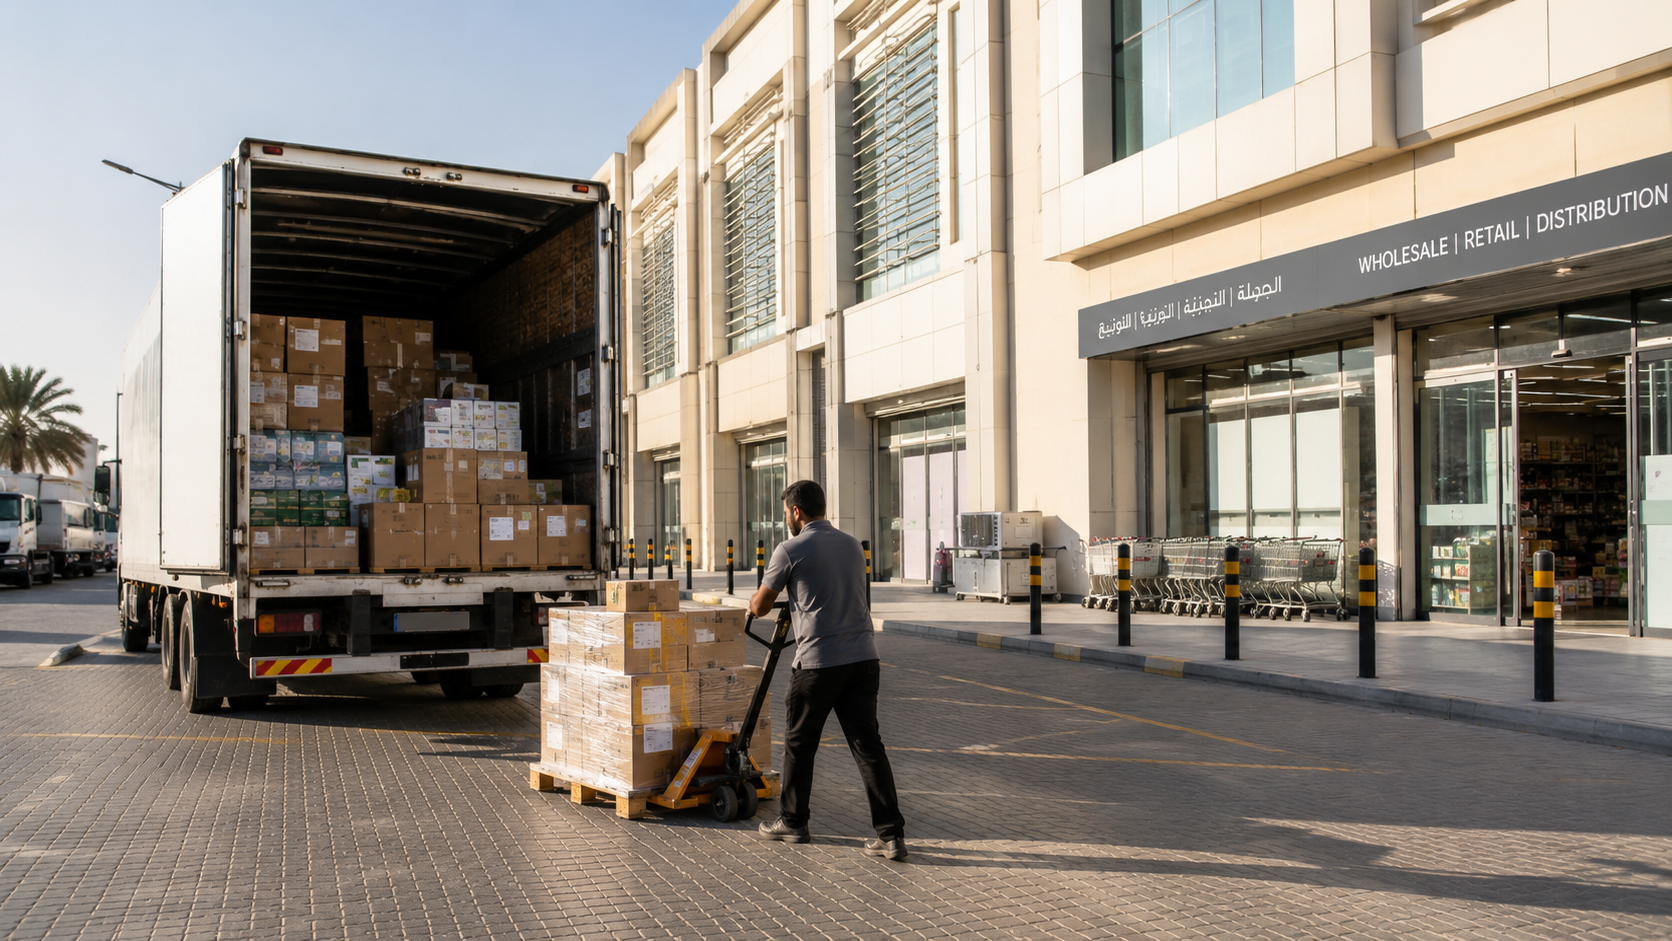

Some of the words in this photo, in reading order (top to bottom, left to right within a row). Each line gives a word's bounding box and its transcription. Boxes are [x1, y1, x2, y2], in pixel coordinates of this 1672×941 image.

[1357, 235, 1449, 274] WHOLESALE
[1464, 220, 1521, 250] RETAIL
[1536, 182, 1668, 234] DISTRIBUTION
